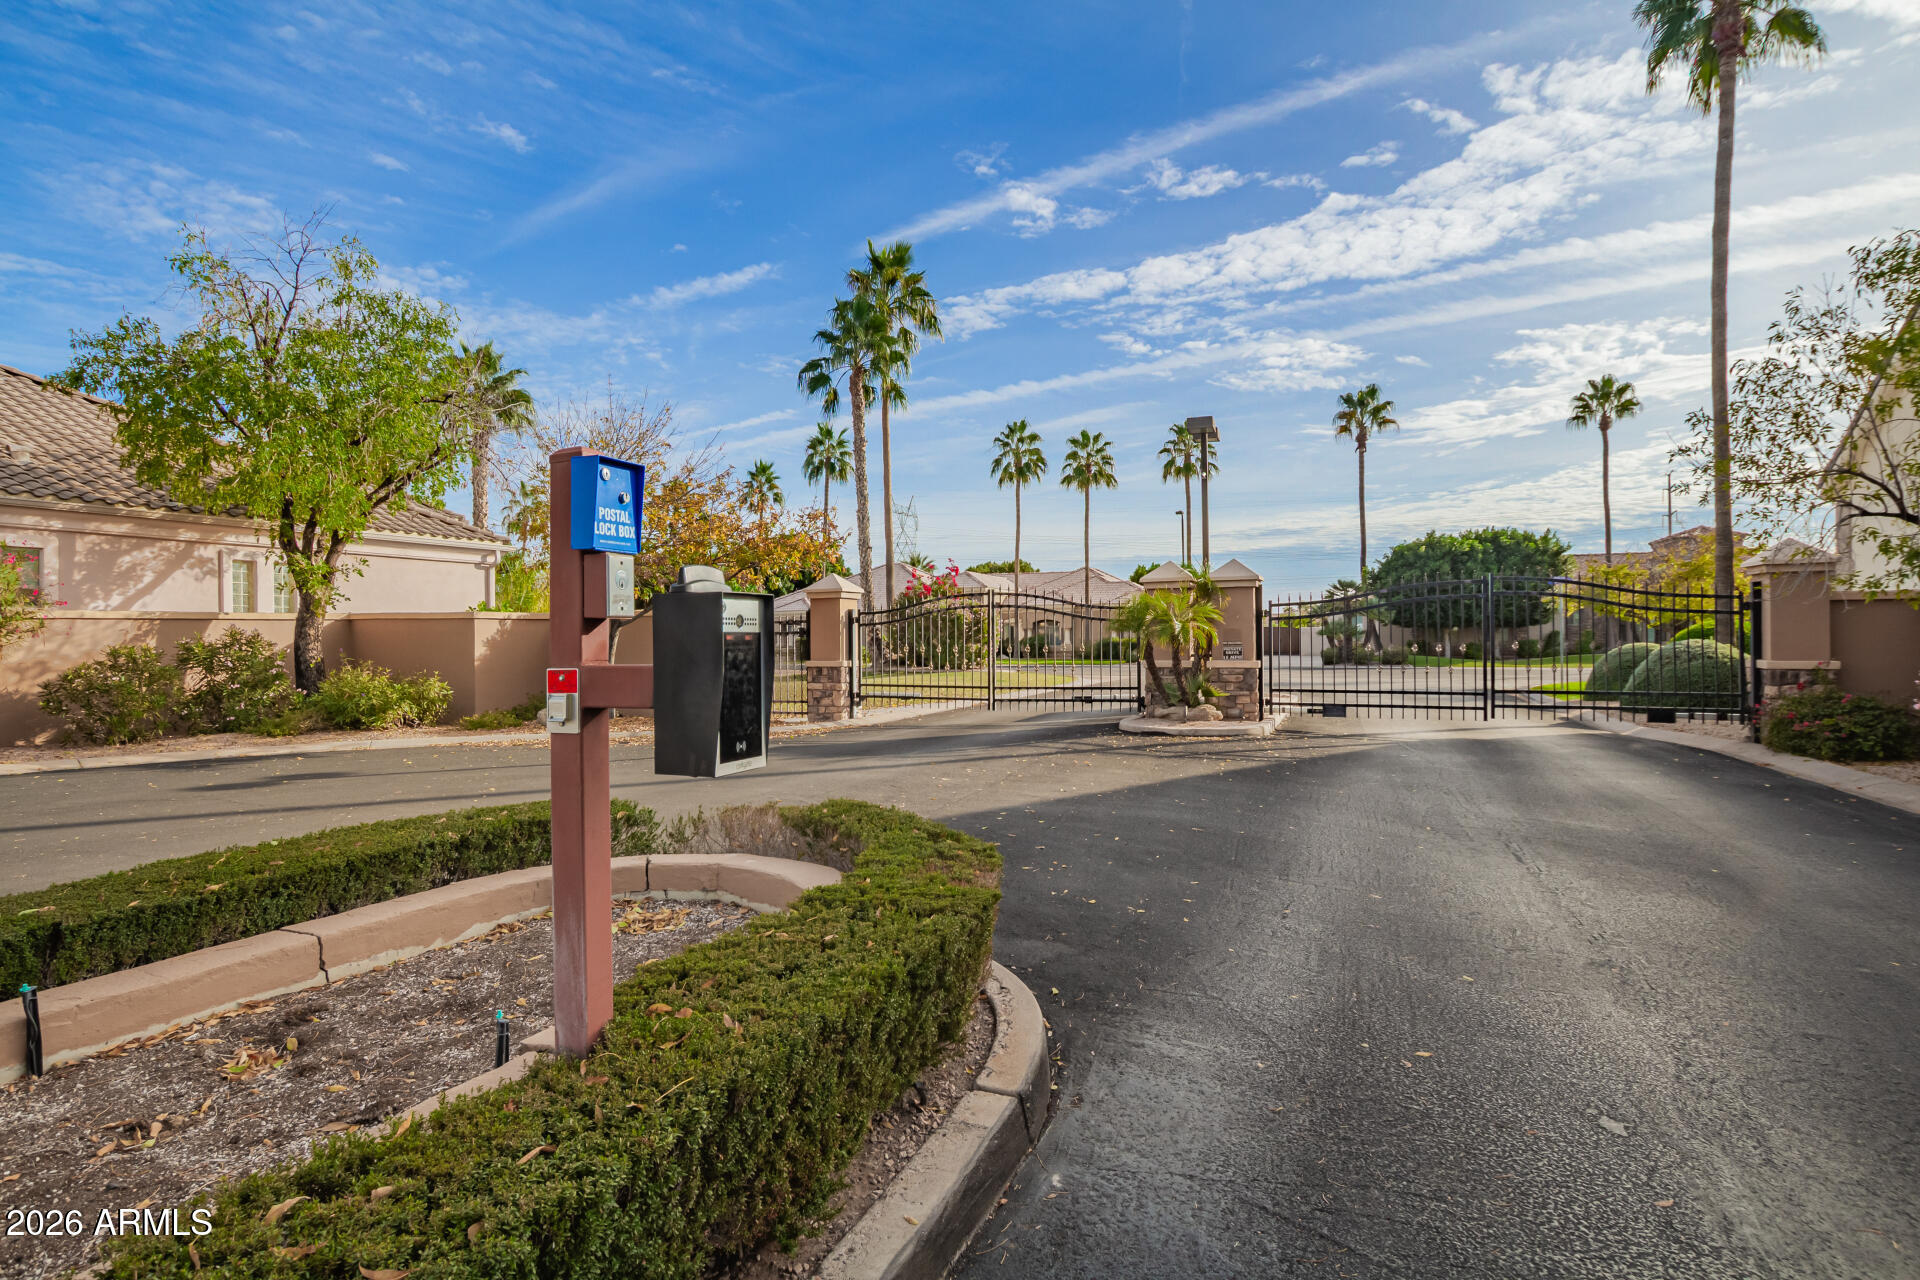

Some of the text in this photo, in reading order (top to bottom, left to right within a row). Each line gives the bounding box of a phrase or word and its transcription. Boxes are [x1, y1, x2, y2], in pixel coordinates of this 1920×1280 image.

[599, 506, 631, 524] POSTAL
[595, 521, 636, 539] LOCK BOX
